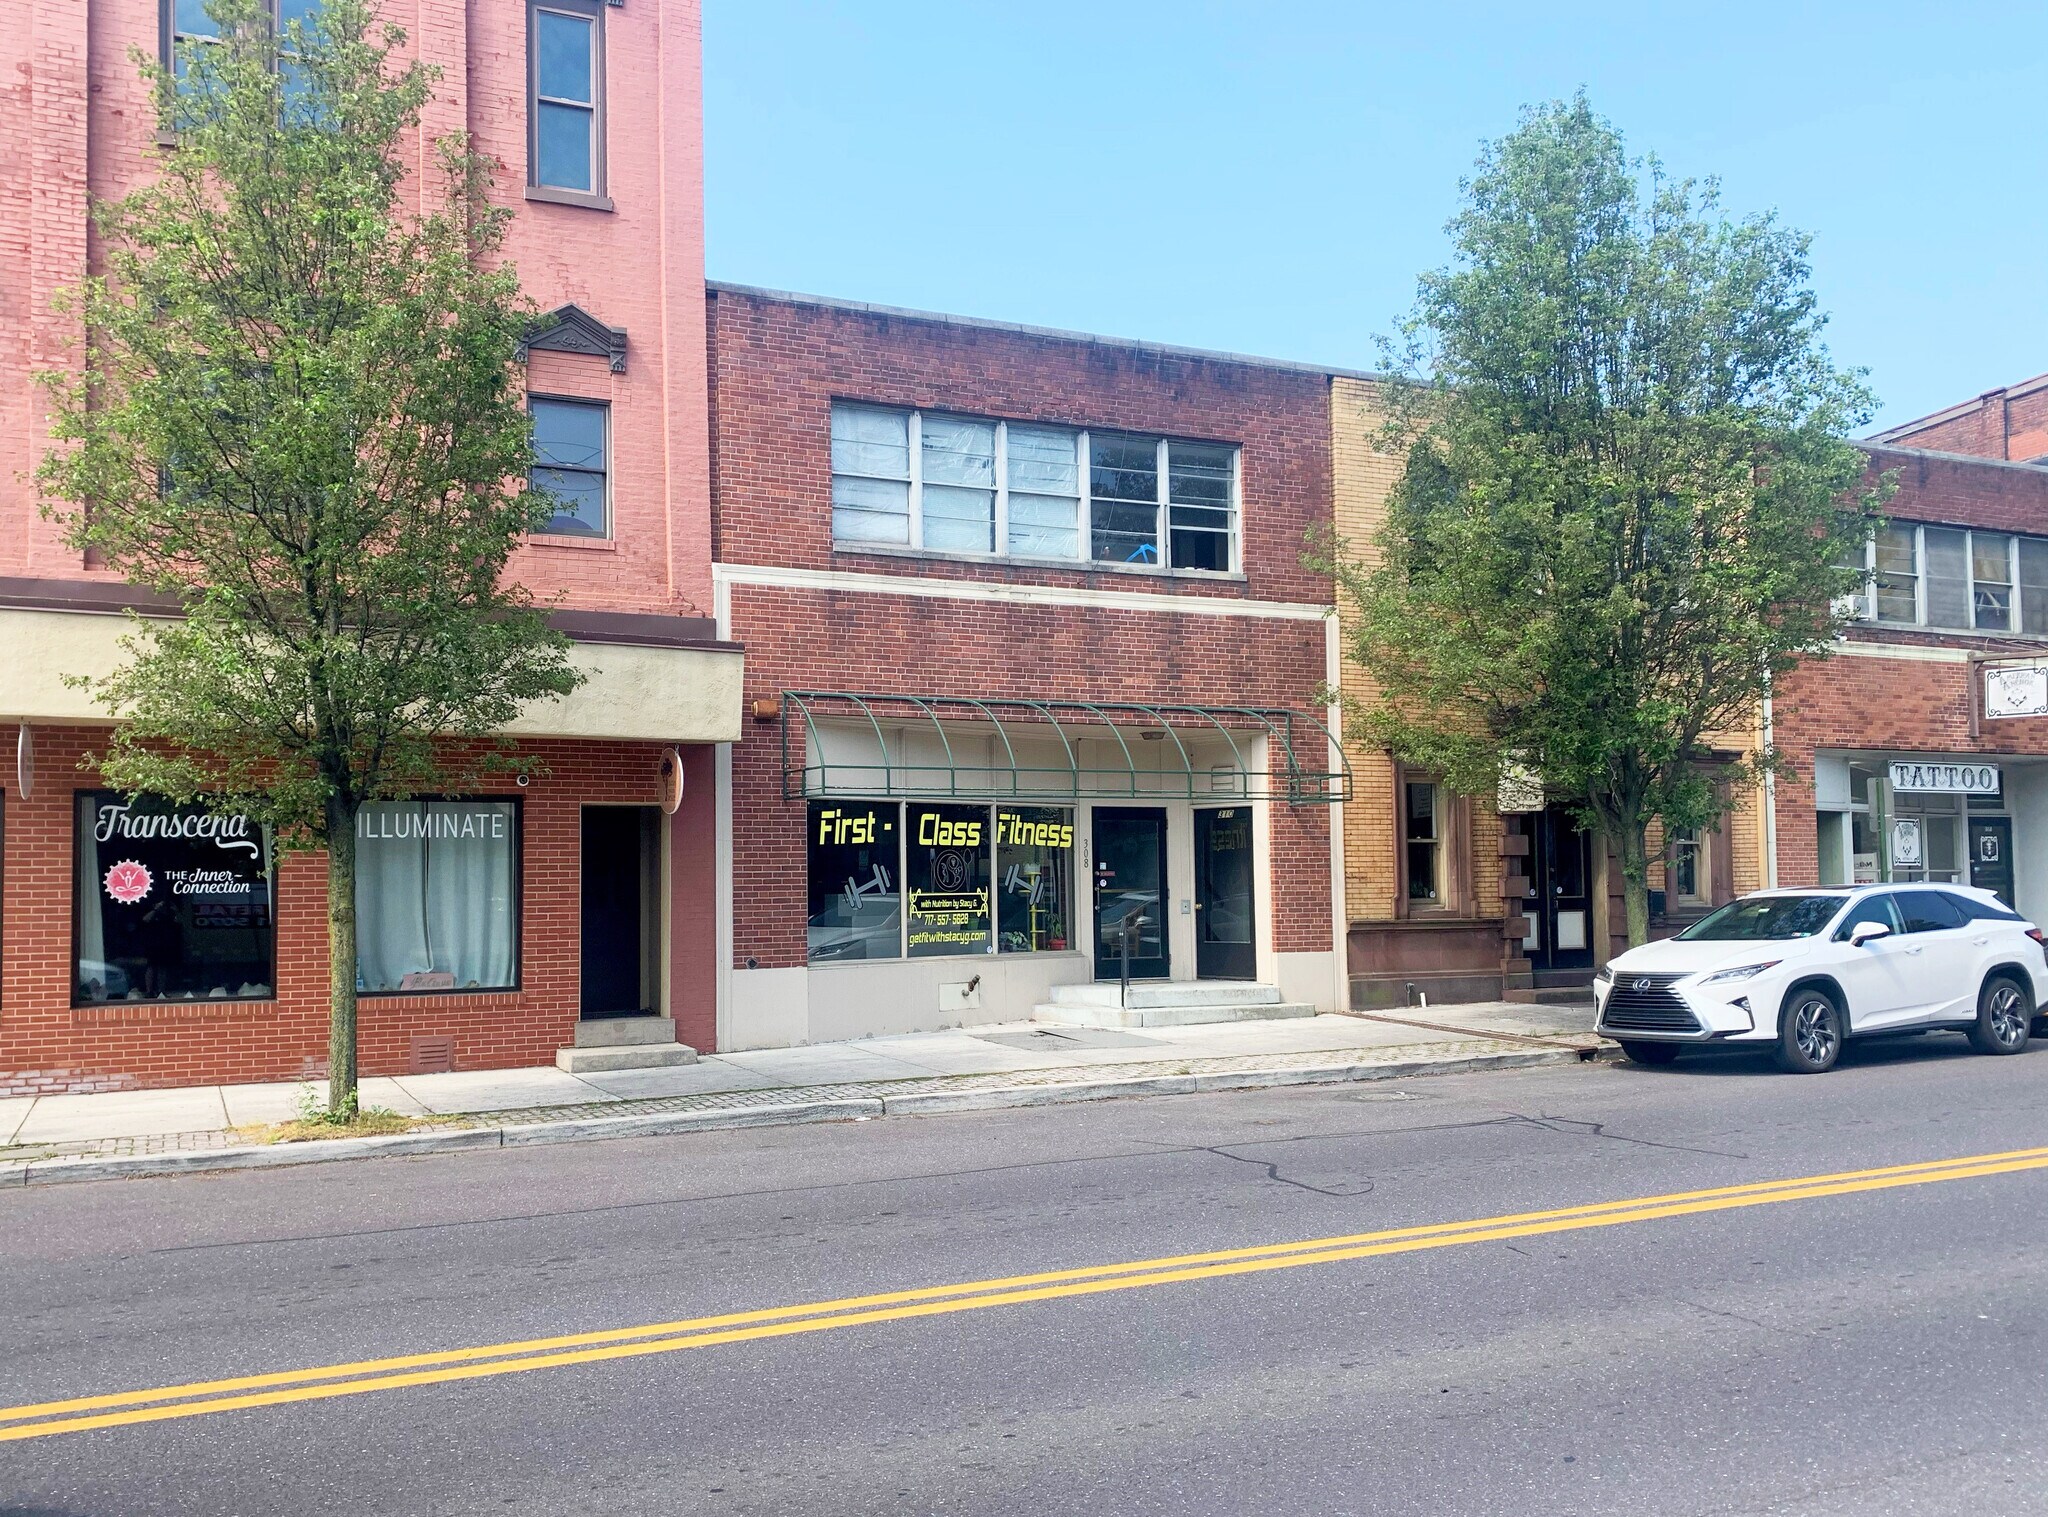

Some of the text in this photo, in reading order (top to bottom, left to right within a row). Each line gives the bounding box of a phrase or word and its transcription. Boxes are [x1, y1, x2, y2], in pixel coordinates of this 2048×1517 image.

[1895, 765, 1993, 790] TATTOO
[358, 812, 504, 839] ILLUMINATE
[819, 808, 876, 845] First
[918, 813, 982, 847] Class
[996, 813, 1074, 848] Fitness
[164, 870, 188, 880] THE
[173, 880, 252, 895] Connection
[932, 899, 953, 908] Nutrition
[953, 899, 960, 909] by
[960, 899, 973, 909] Stacy
[908, 930, 987, 948] getfitwithstacyg.com
